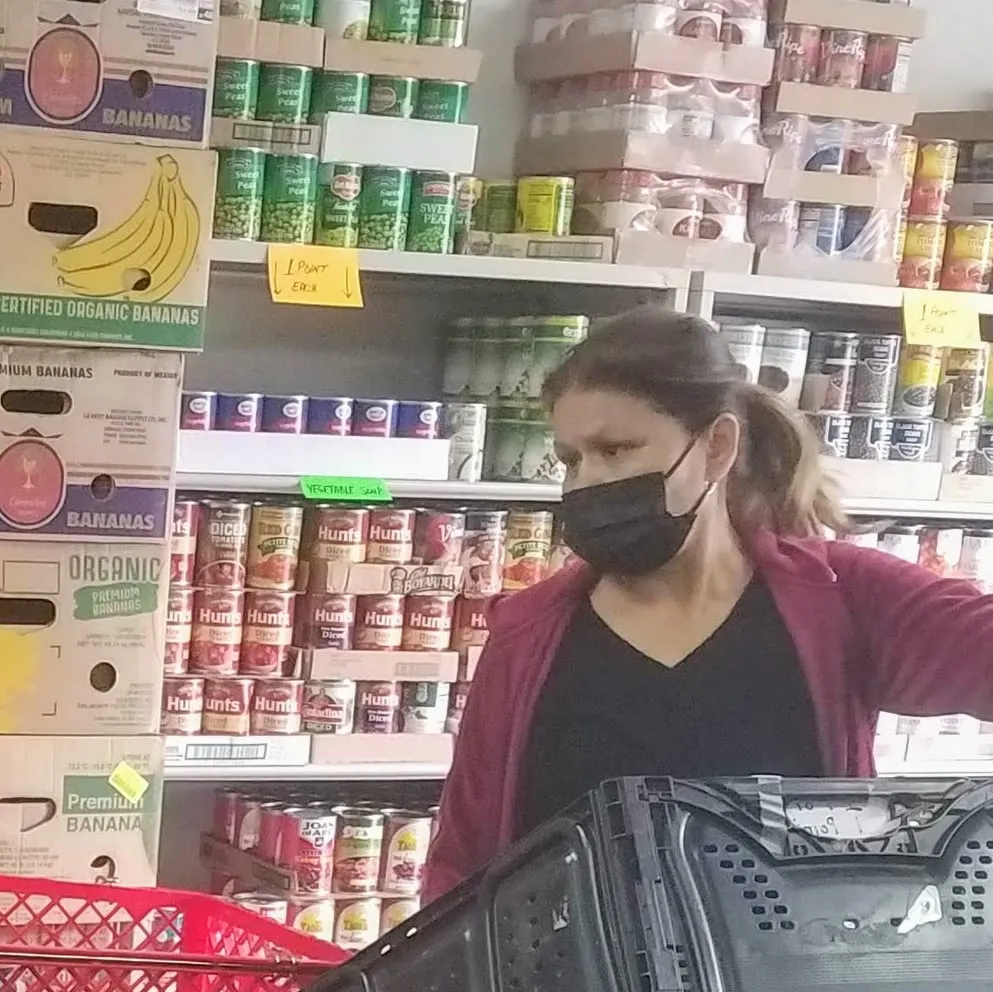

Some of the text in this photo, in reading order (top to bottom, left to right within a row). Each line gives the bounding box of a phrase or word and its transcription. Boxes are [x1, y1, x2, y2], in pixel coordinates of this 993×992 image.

[102, 108, 192, 133] BANANAS
[66, 299, 130, 322] ORGANIC
[131, 304, 199, 327] BANANAS
[35, 365, 93, 380] BANANAS
[113, 369, 143, 378] PRODUCT
[305, 484, 355, 496] VEGETABLE
[66, 510, 156, 531] BANANAS
[210, 522, 248, 537] DICED
[69, 554, 161, 583] ORGANIC
[91, 588, 140, 603] PREMIUM
[92, 600, 142, 617] BANANAS
[66, 815, 142, 833] BANANA
